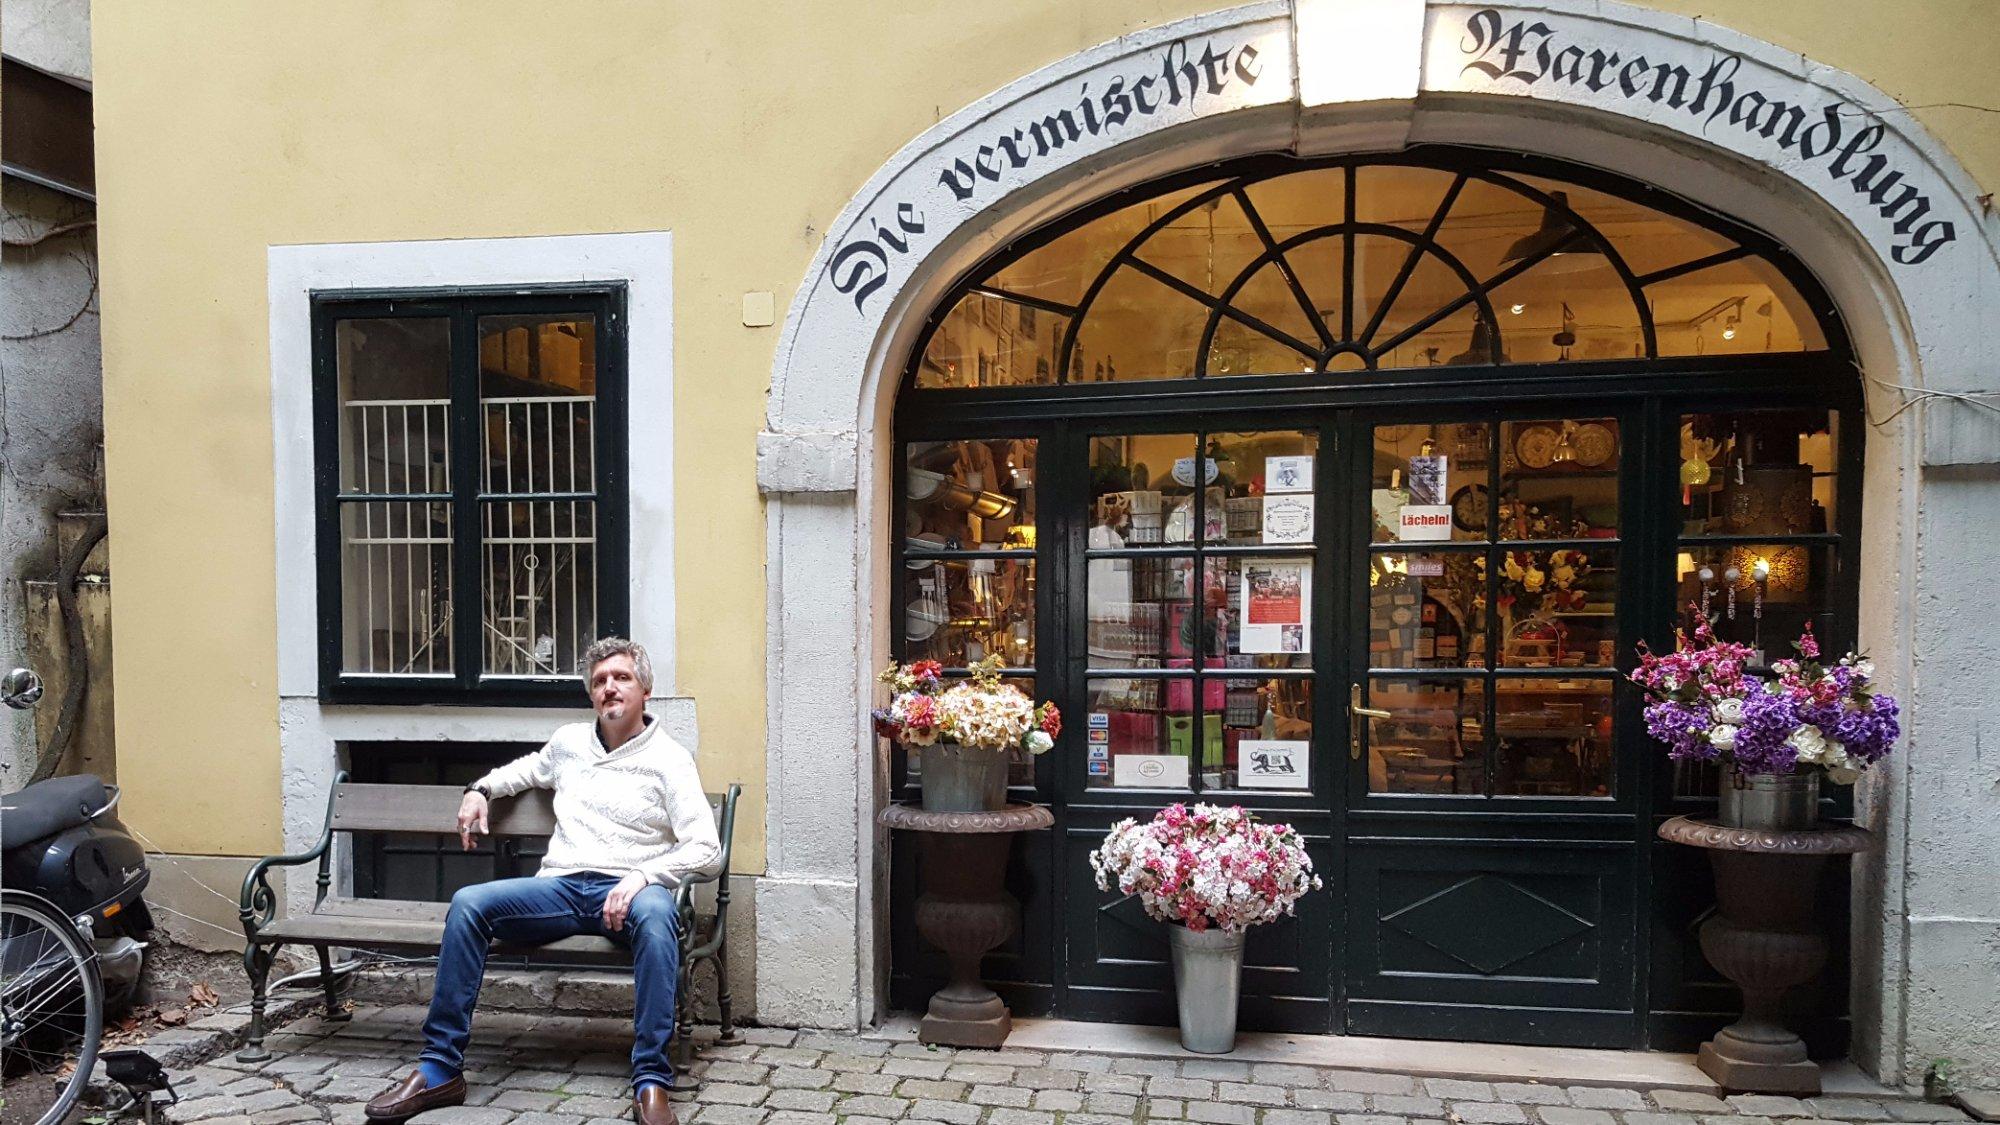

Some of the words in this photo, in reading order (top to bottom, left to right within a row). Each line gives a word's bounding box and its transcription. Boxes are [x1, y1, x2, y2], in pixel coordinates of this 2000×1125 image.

[829, 201, 927, 317] Die
[938, 38, 1263, 201] vermischte
[1459, 9, 1956, 266] Warenhandlung
[1402, 514, 1450, 526] Lächeln!
